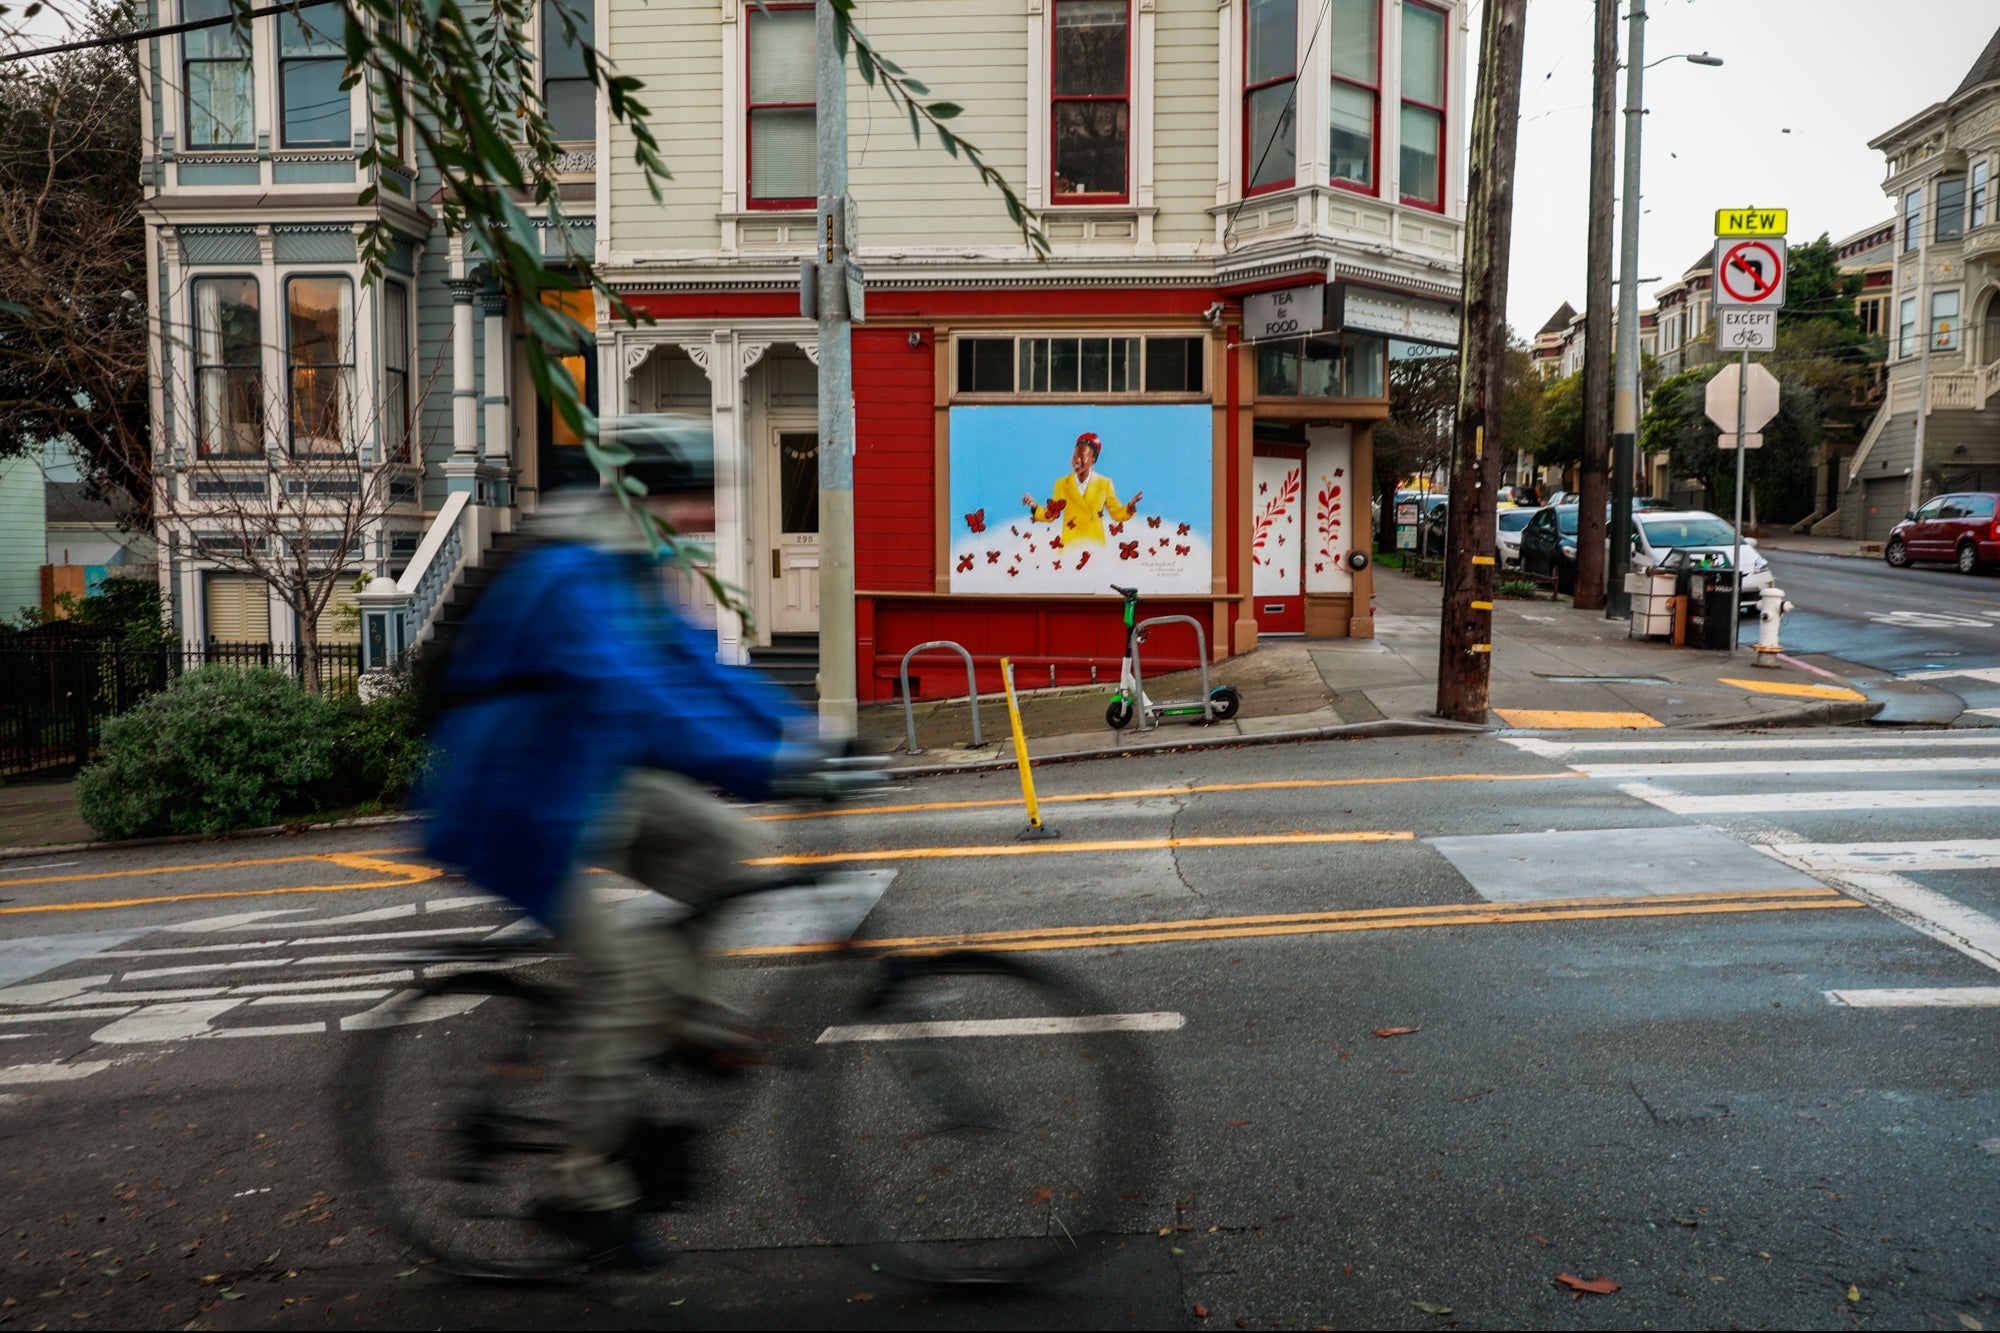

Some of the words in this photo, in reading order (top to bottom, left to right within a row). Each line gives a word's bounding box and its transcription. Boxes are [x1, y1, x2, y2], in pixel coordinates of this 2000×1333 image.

[1729, 214, 1776, 230] NEW
[1272, 291, 1293, 306] TEA
[1277, 307, 1287, 319] &
[1726, 313, 1770, 325] EXCEPT
[1266, 319, 1298, 335] FOOD
[796, 535, 814, 544] 295
